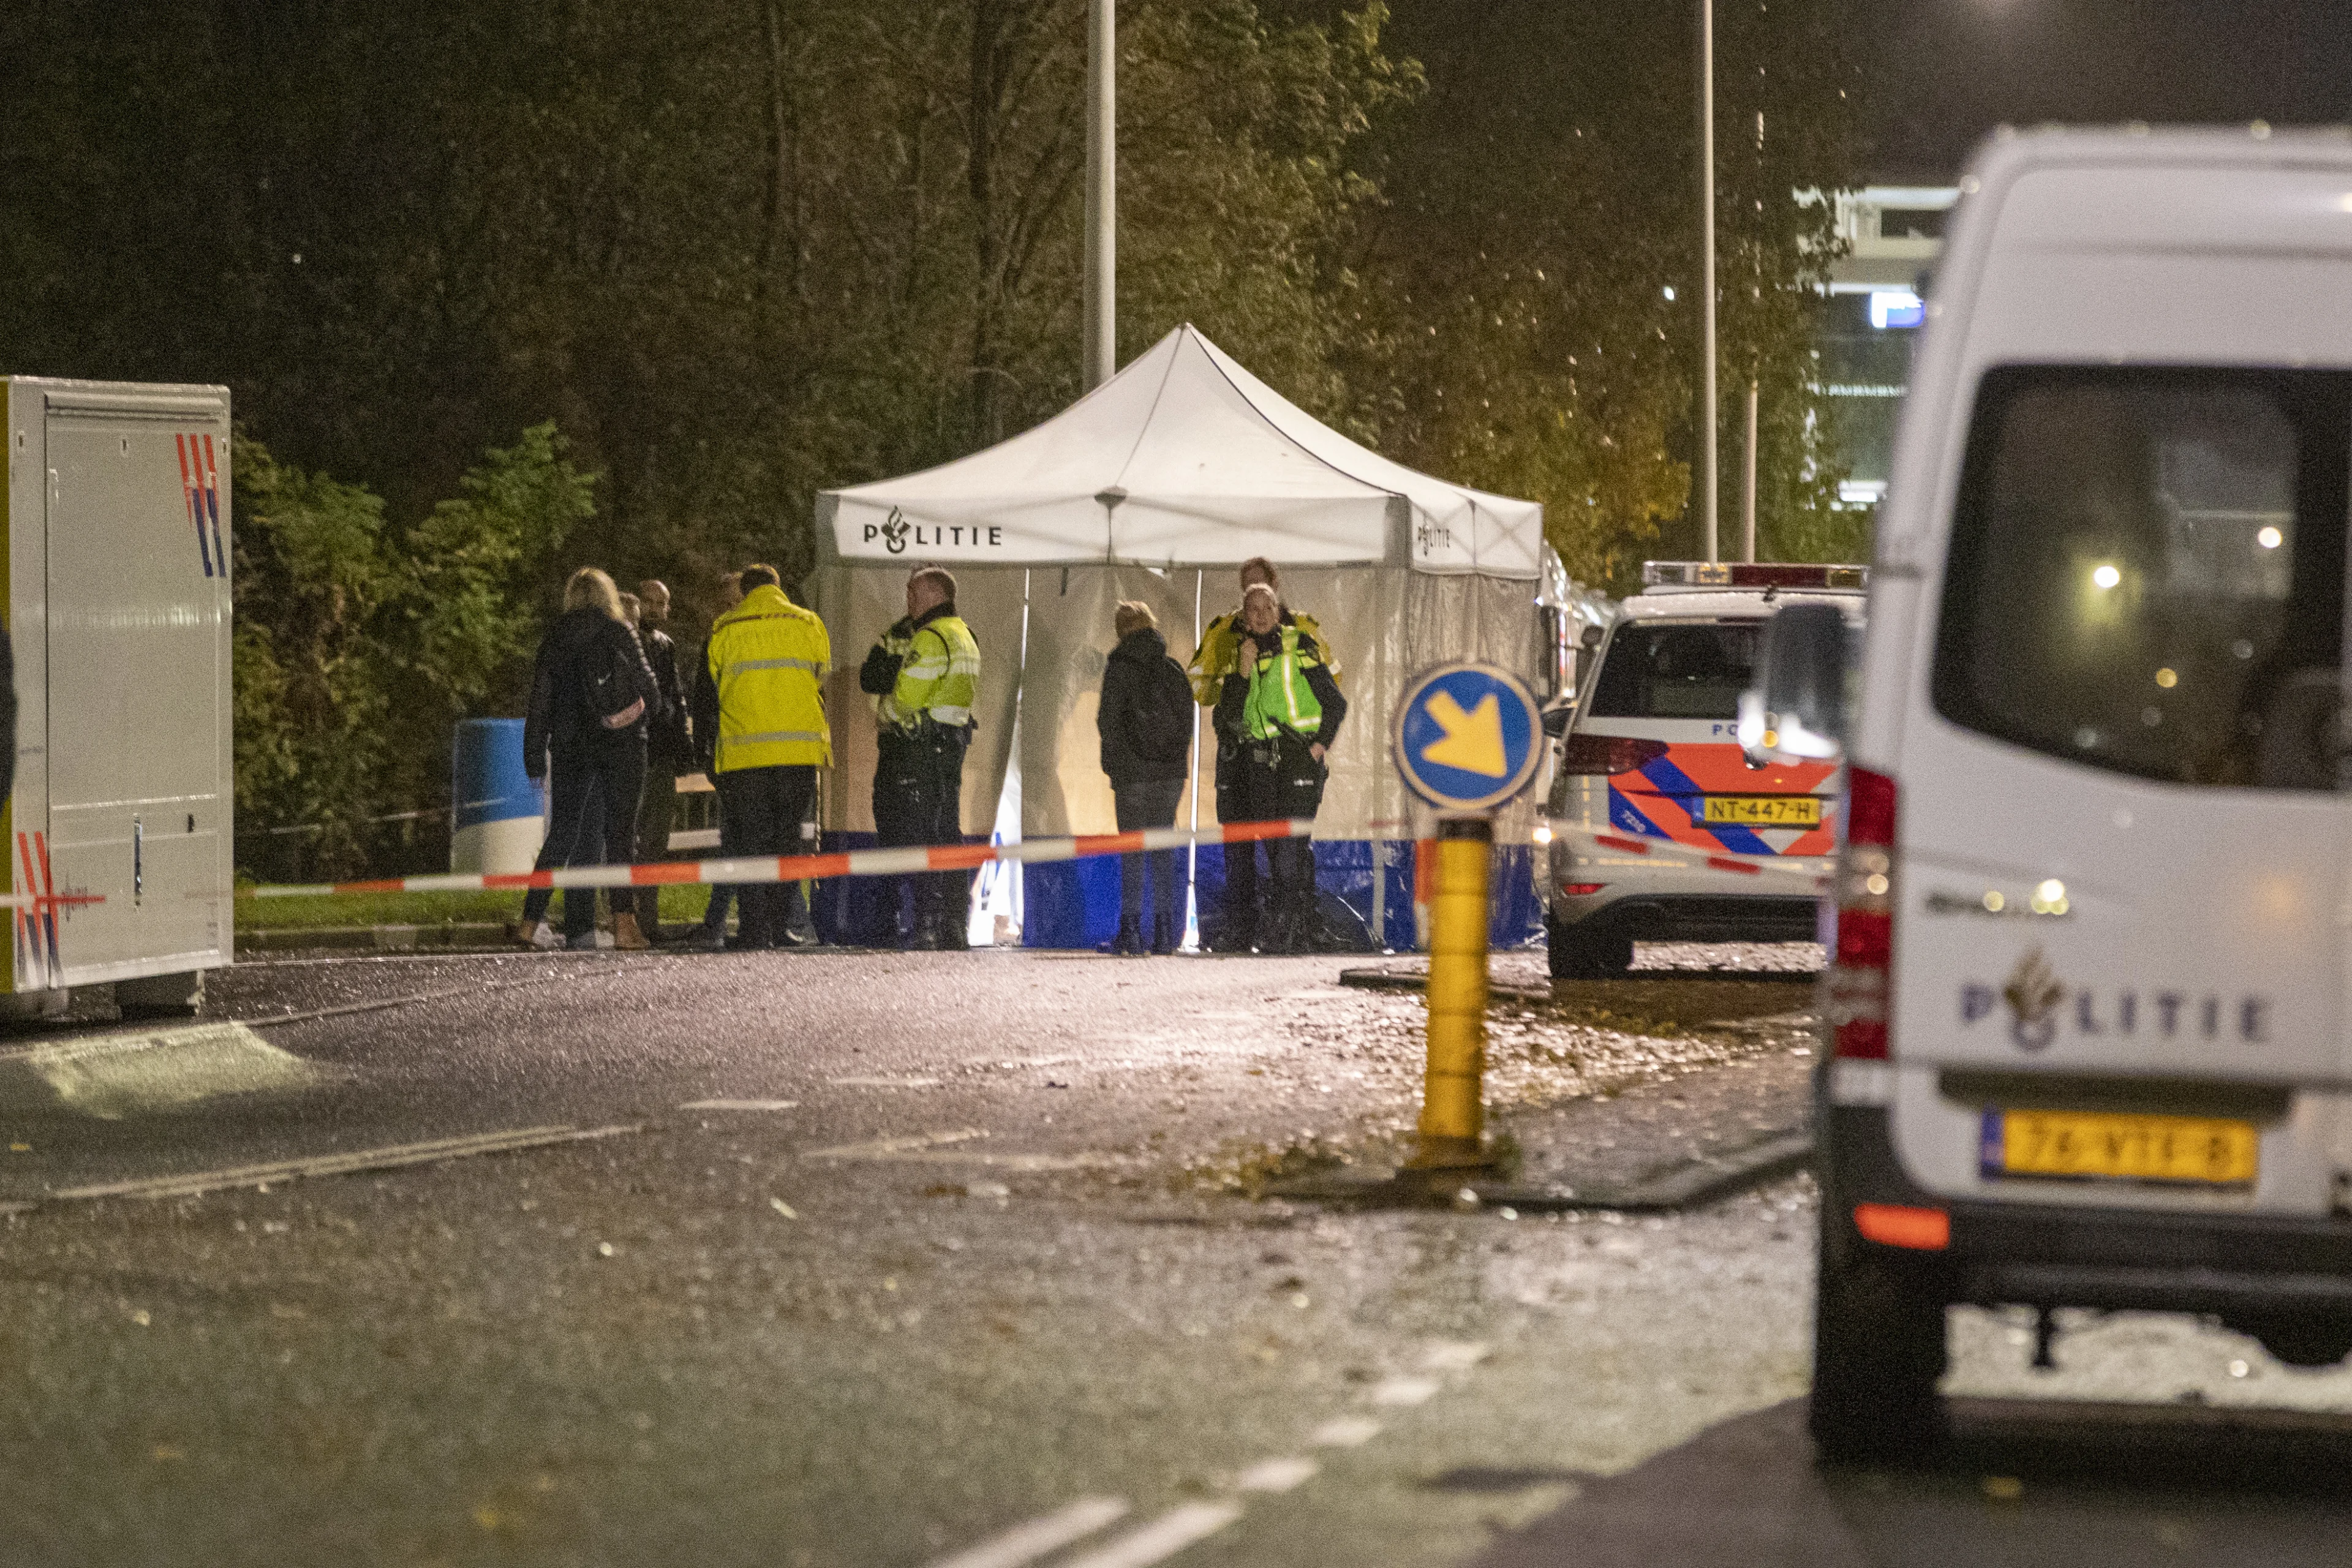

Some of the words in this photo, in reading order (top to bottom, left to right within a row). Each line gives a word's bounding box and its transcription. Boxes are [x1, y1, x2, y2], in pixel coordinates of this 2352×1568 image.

[863, 518, 1002, 554] POLITIE
[1711, 800, 1811, 820] NT-447-H
[1960, 974, 2270, 1052] POLITIE
